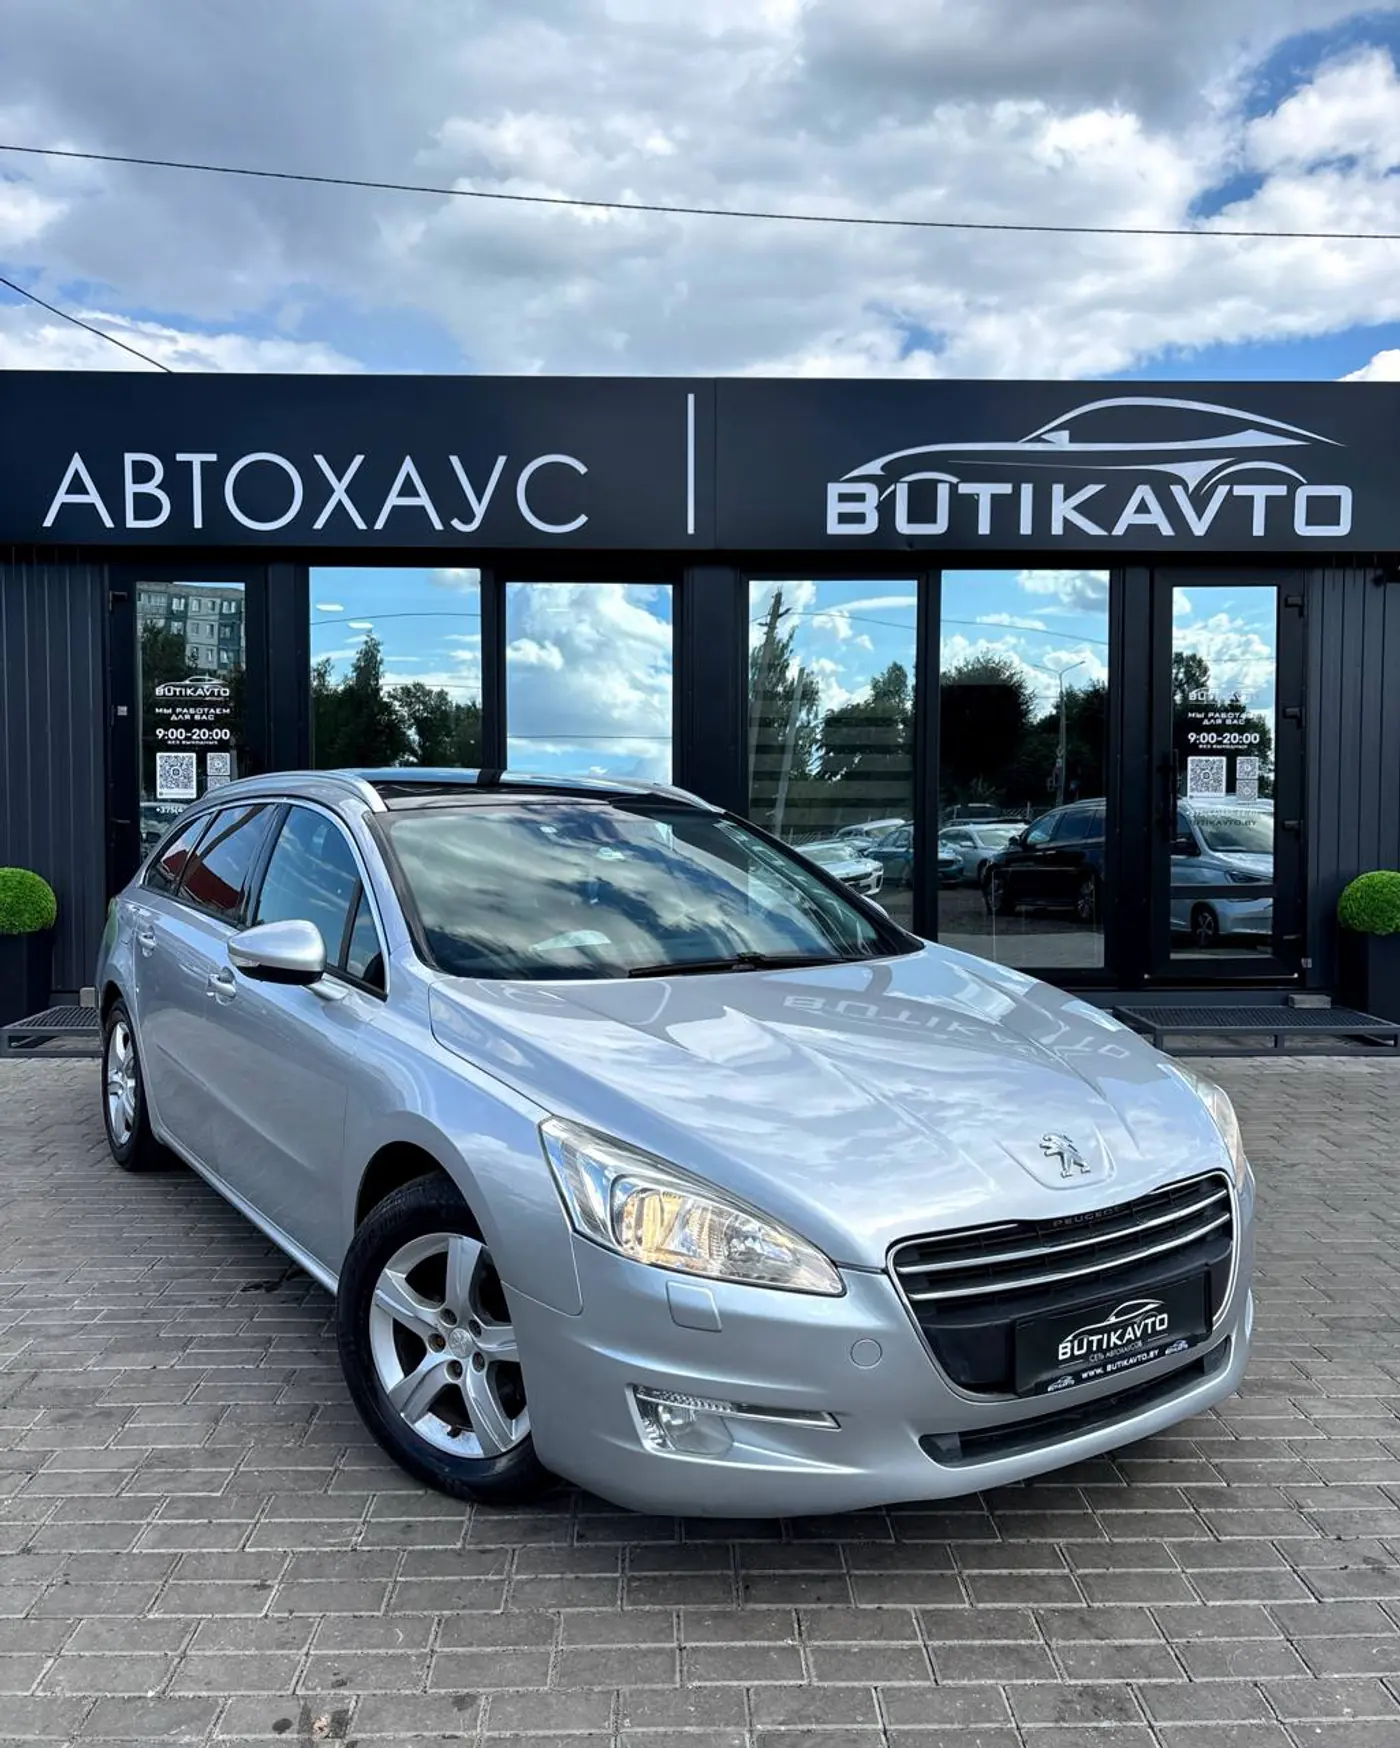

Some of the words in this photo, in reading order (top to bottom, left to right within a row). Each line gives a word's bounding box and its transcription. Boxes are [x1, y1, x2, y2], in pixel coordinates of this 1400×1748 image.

[42, 452, 588, 533] АВТОХАУС
[826, 482, 1353, 537] BUTIKAVTO
[155, 686, 230, 697] BUTIKAVTO
[155, 728, 231, 740] 9:00-20:00
[1187, 732, 1261, 744] 9:00-20:00
[1058, 1313, 1168, 1360] BUTIKAVTO
